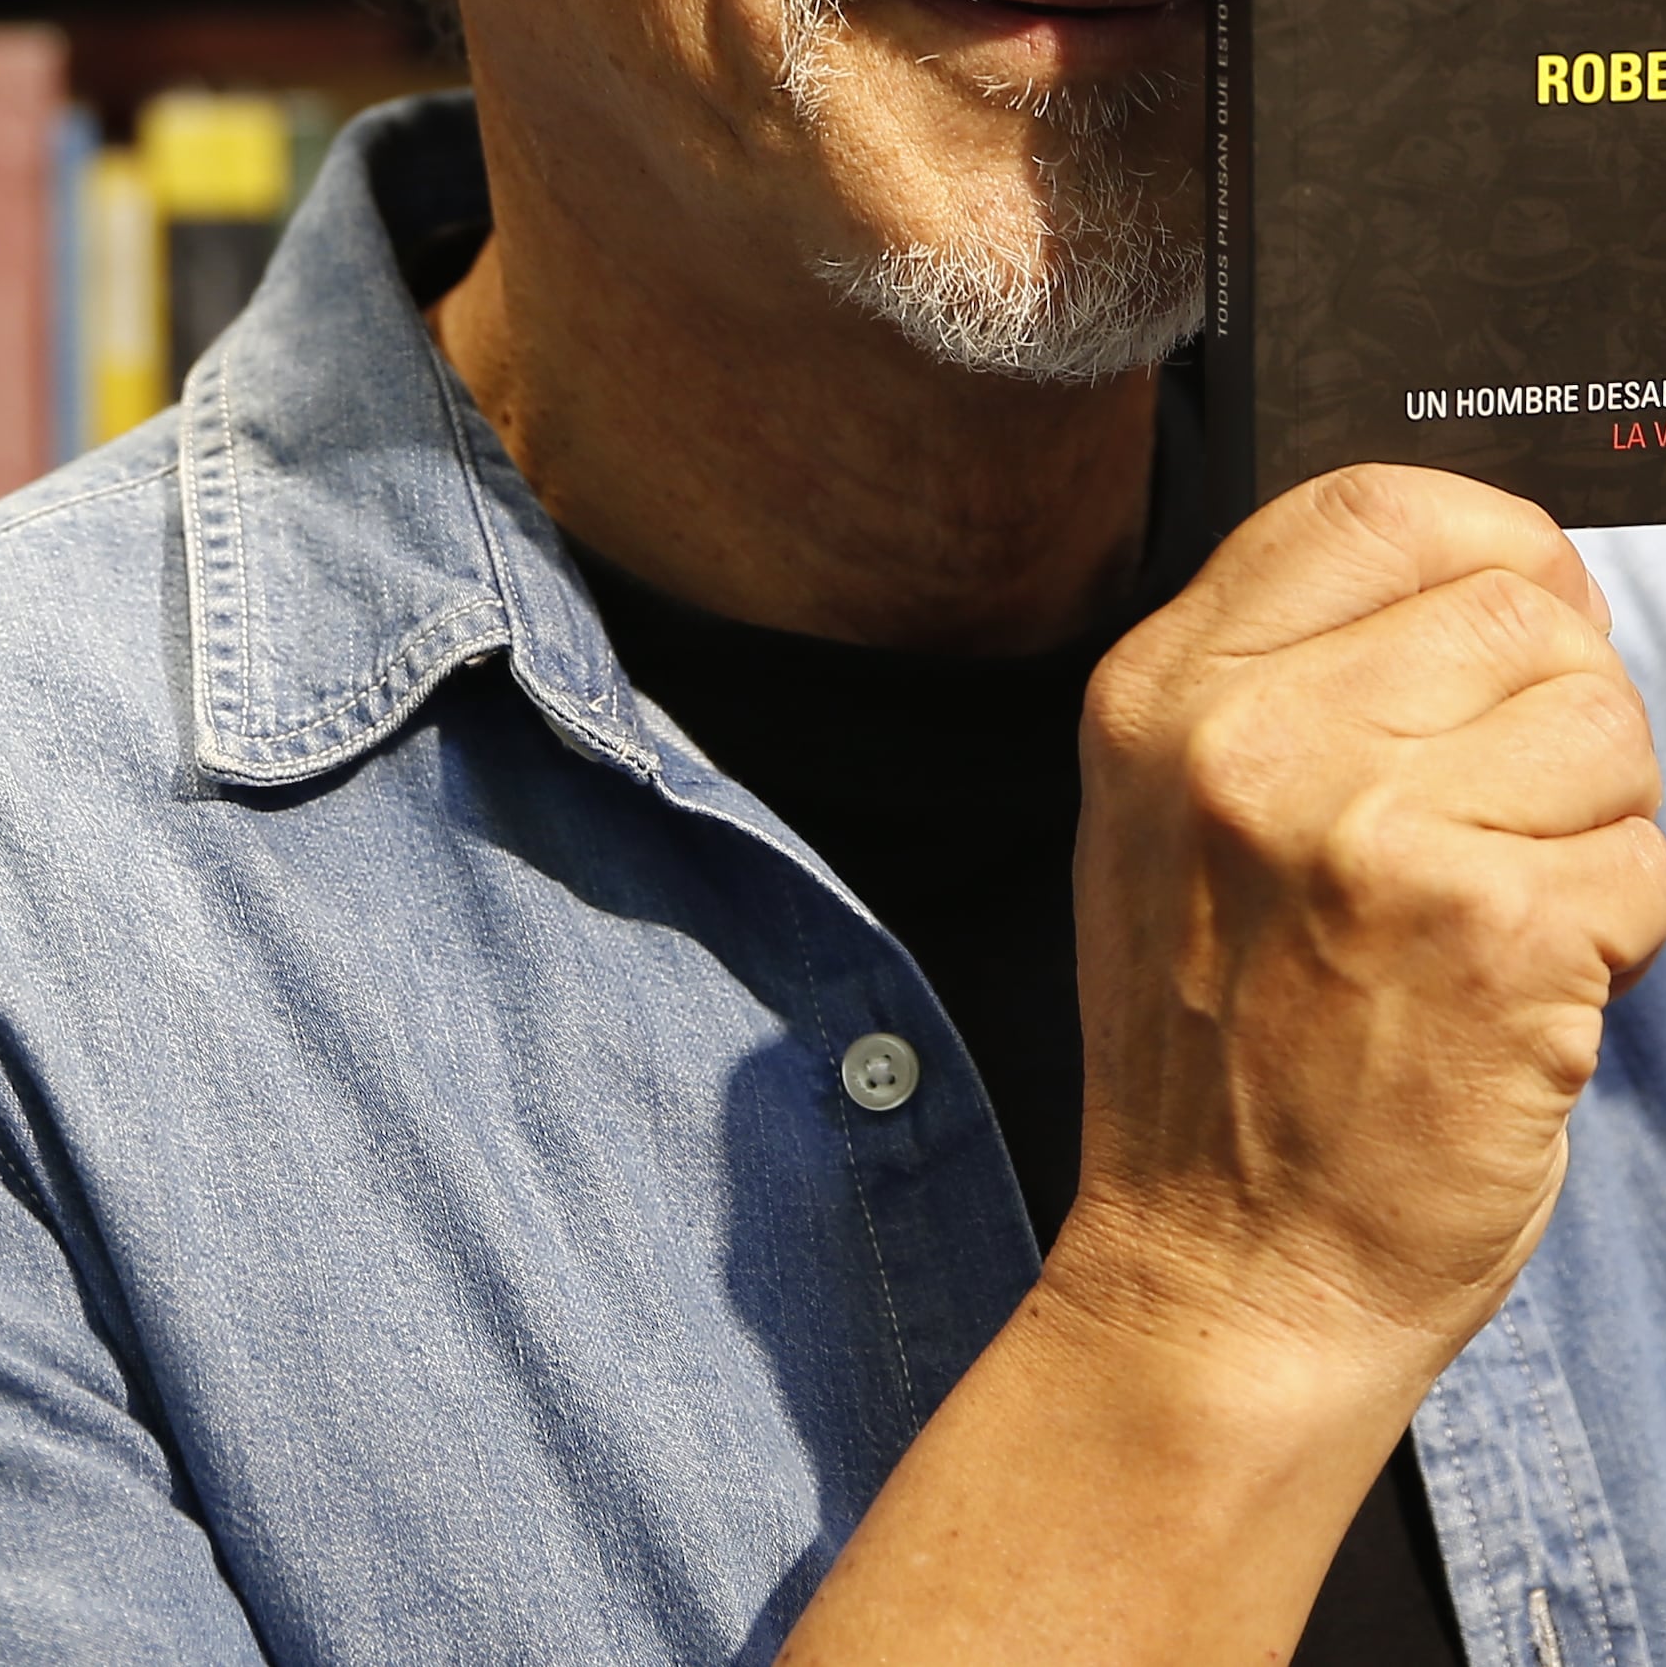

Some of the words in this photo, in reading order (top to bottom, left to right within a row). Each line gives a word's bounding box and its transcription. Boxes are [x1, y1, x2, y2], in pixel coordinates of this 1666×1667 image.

[1217, 75, 1229, 125] QUE
[1217, 133, 1229, 246] PIENSAN
[1217, 253, 1229, 338] TODOS
[1405, 390, 1448, 421] UN
[1455, 383, 1580, 418] HOMBRE
[1612, 422, 1647, 450] LA
